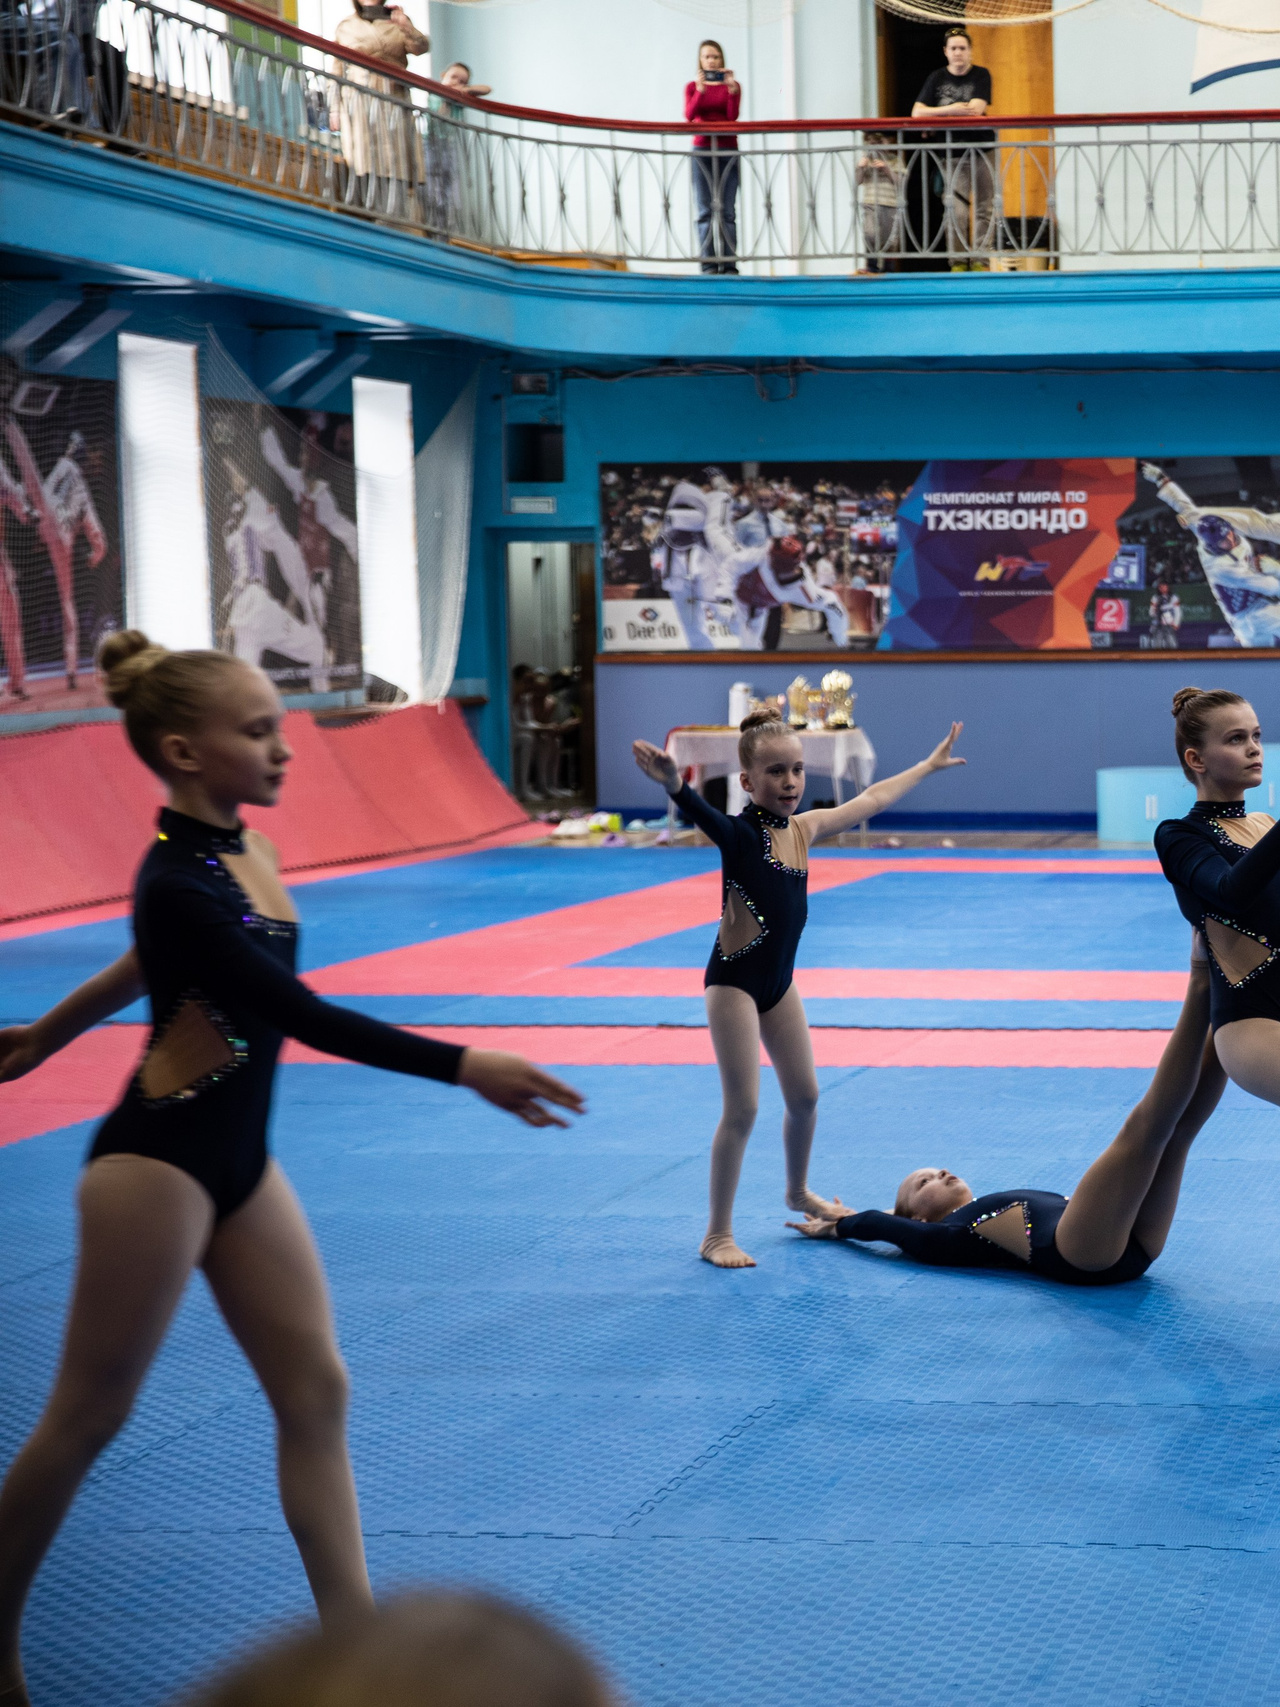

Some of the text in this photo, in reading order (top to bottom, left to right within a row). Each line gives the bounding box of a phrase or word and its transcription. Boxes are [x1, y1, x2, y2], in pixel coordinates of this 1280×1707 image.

[923, 491, 1087, 505] ЧЕМПИОНАТ МИРА ПО
[922, 508, 1088, 534] ТХЭКВОНДО
[1102, 600, 1117, 622] 2
